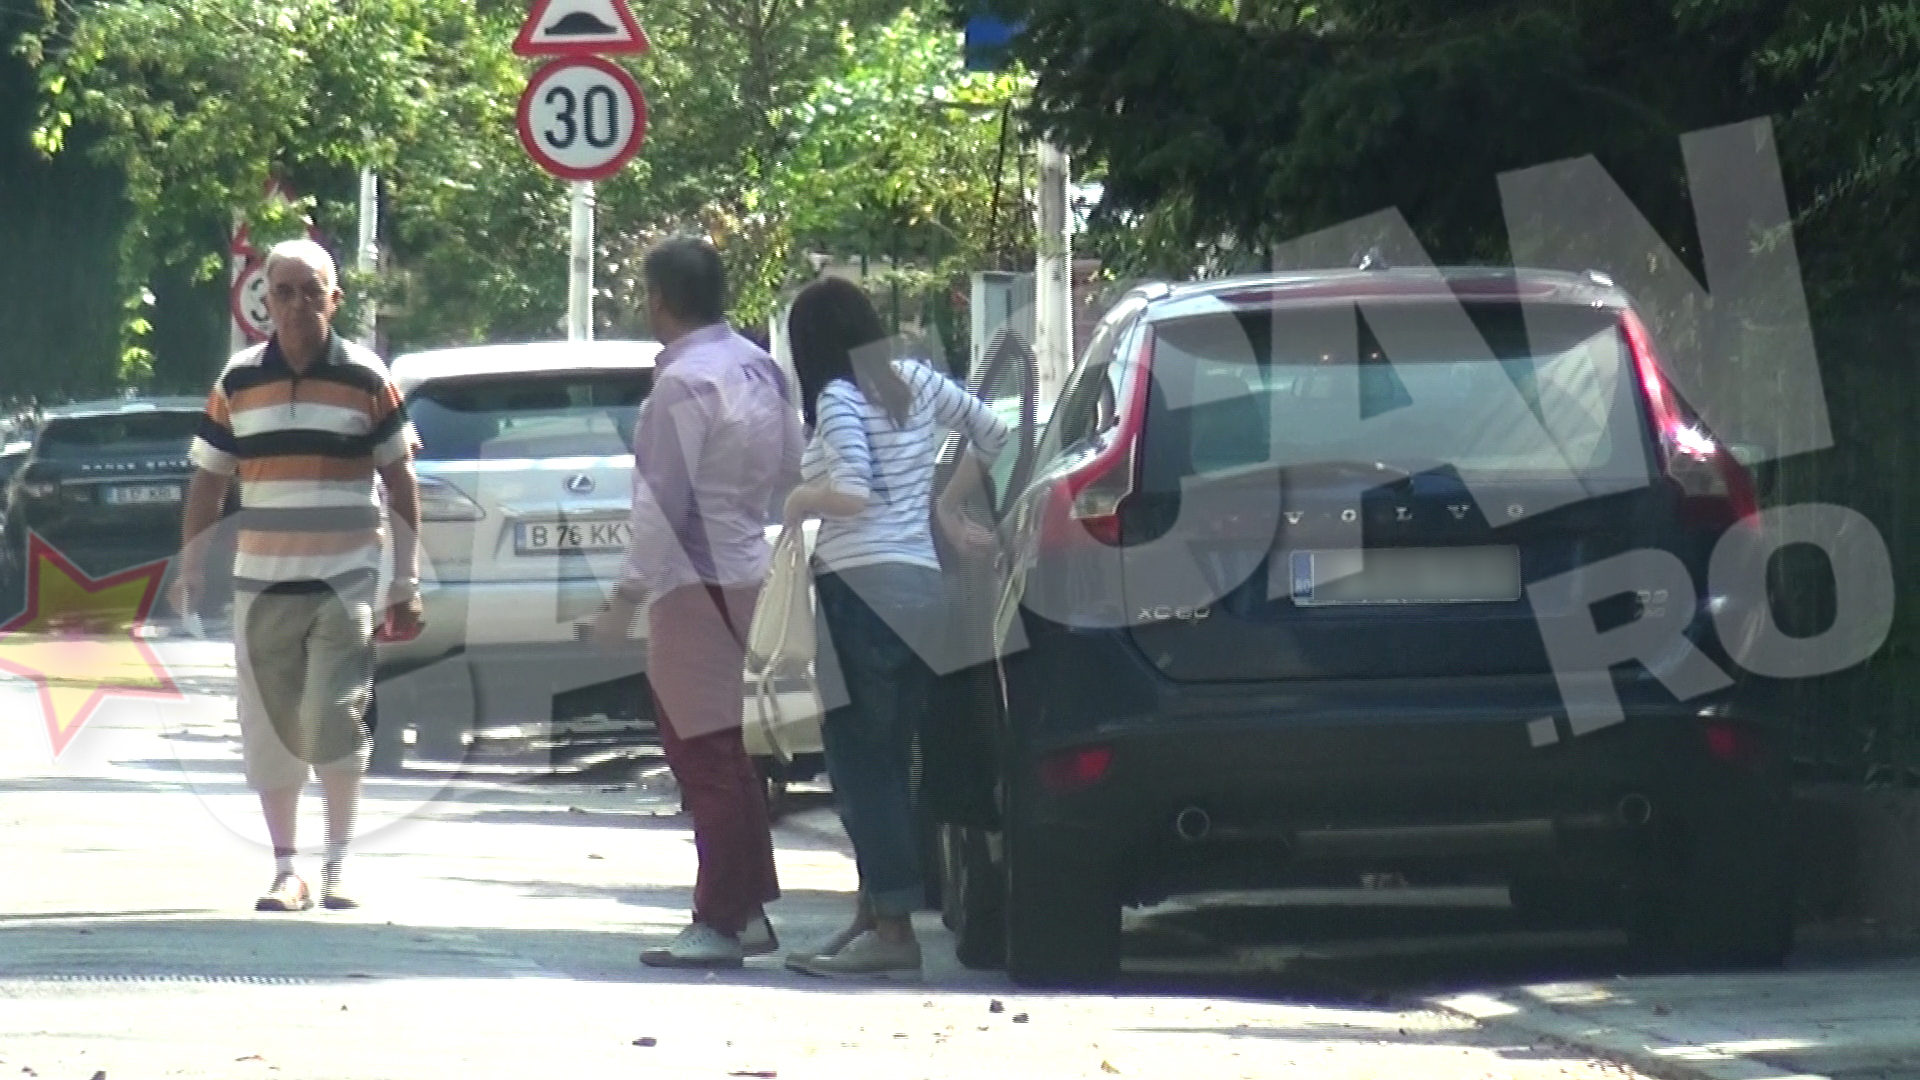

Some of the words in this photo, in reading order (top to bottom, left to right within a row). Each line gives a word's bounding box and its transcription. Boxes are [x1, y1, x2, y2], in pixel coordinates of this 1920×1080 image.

[544, 85, 620, 149] 30
[1283, 503, 1524, 525] VOLVO
[532, 525, 548, 547] B
[557, 524, 583, 546] 76
